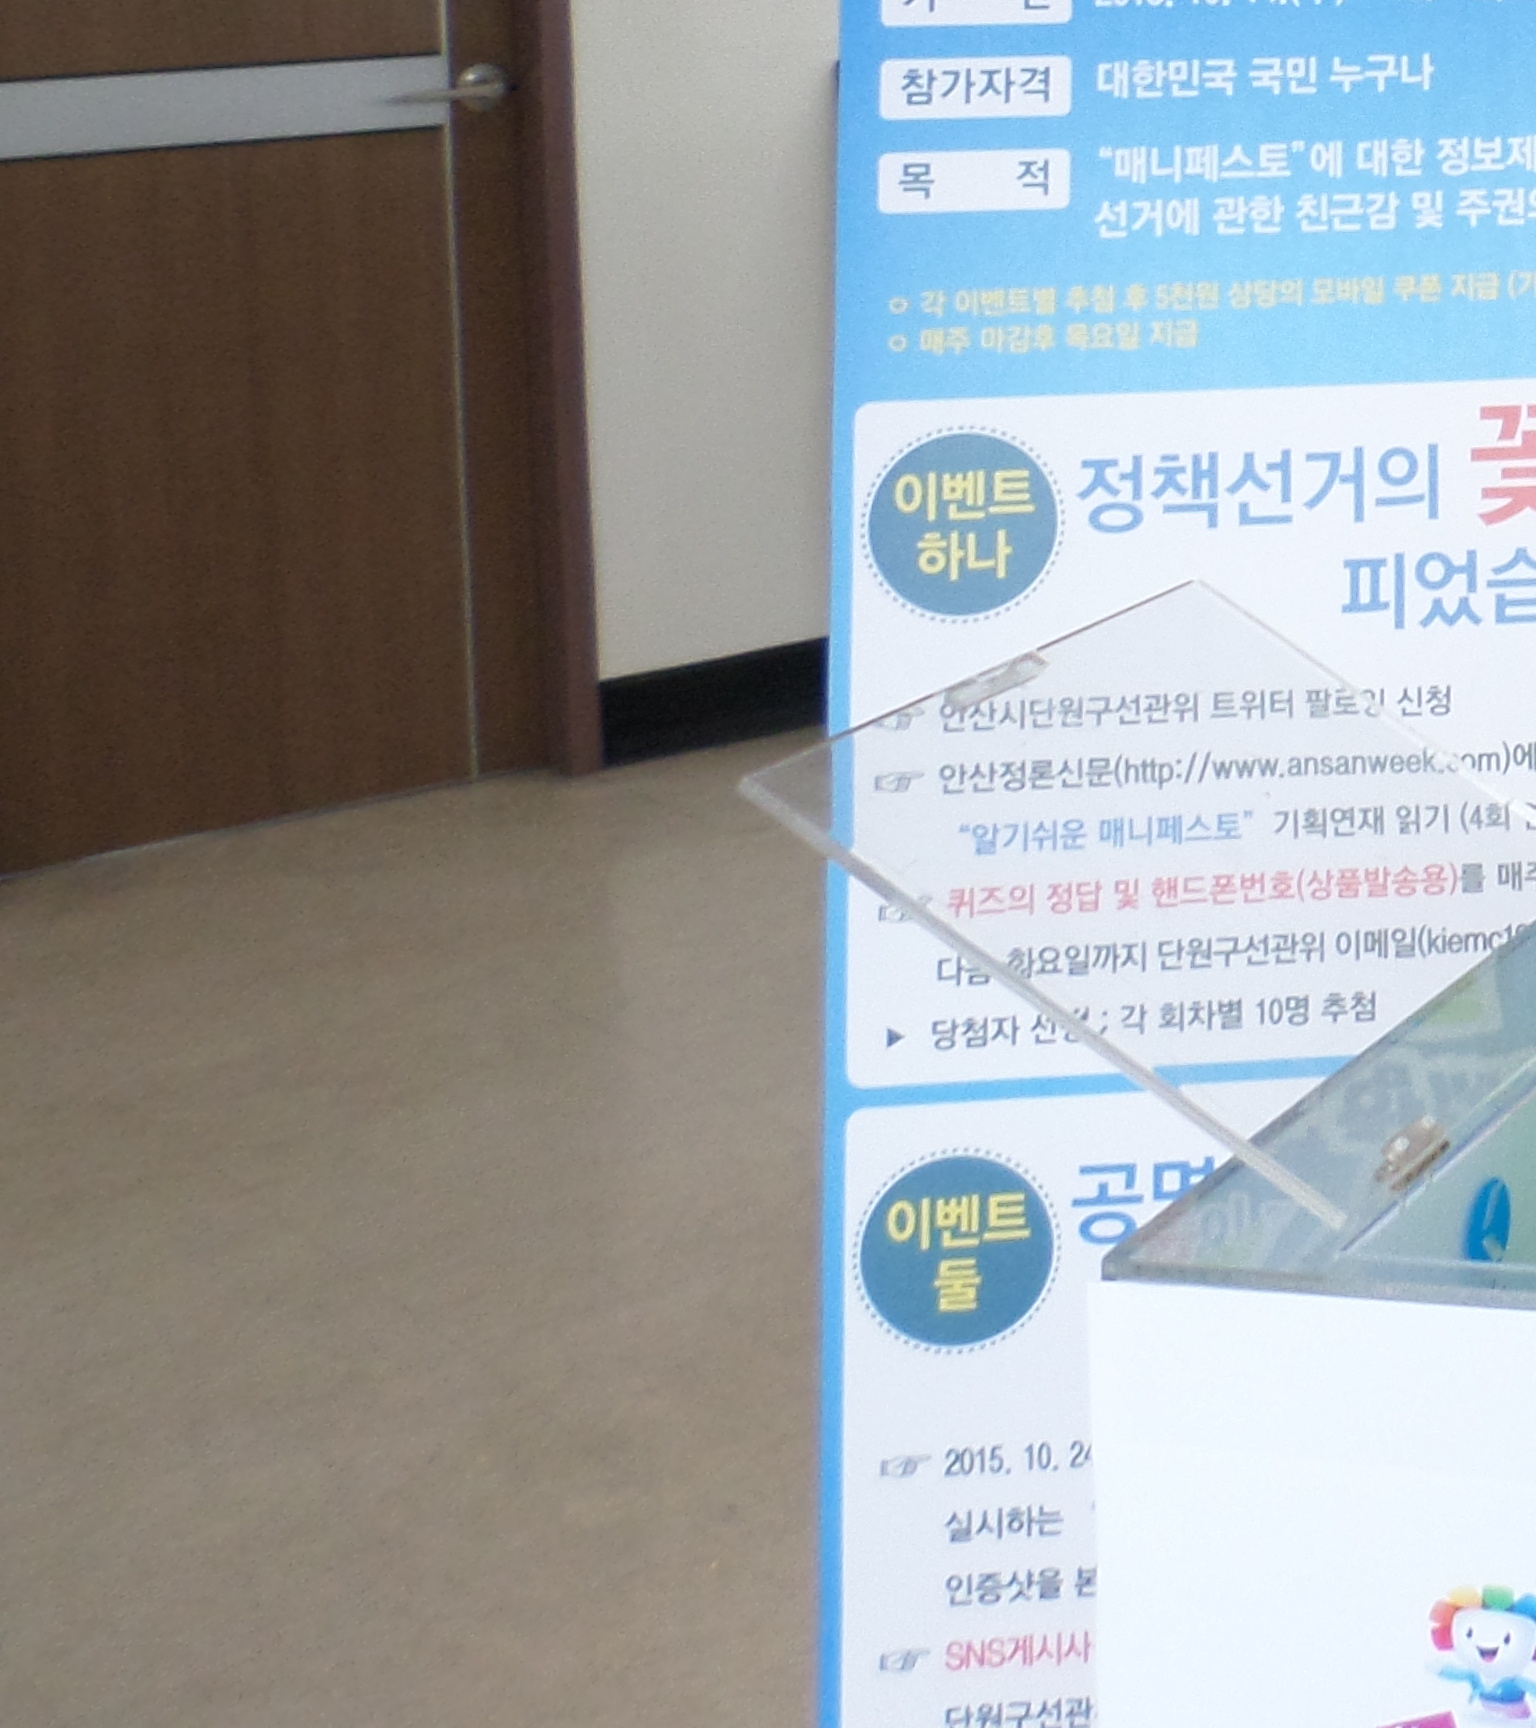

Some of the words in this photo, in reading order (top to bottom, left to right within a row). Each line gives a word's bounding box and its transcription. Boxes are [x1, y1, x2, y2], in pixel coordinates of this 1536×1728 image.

[901, 66, 1051, 106] 참가자격
[1095, 58, 1237, 99] 대한민국
[1248, 56, 1317, 95] 국민
[1330, 52, 1434, 93] 누구나
[1356, 138, 1425, 178] 대한
[1094, 197, 1200, 239] 선거에
[1213, 194, 1285, 235] 관한
[1296, 191, 1400, 233] 친근감
[1411, 190, 1443, 229] 및
[921, 289, 947, 317] 각
[955, 285, 1057, 317] 이벤트별
[1065, 283, 1116, 314] 추첨
[1155, 280, 1221, 311] 5천원
[1229, 277, 1304, 310] 상당의
[1311, 275, 1386, 305] 모바일
[1393, 273, 1442, 303] 쿠폰
[1451, 271, 1501, 301] 지급
[919, 326, 971, 356] 매주
[980, 323, 1055, 354] 마감후
[1065, 320, 1141, 352] 목요일
[1149, 318, 1198, 349] 지급
[894, 466, 1037, 526] 이벤트
[1075, 441, 1443, 534] 정책선거의
[917, 530, 1012, 584] 하나
[938, 690, 1200, 733] 안산시단원구선관위
[1210, 688, 1295, 721] 트위터
[1397, 684, 1453, 718] 신청
[1273, 804, 1386, 839] 기획연재
[1395, 802, 1450, 835] 읽기
[1459, 799, 1511, 835] (4회
[947, 883, 1036, 919] 퀴즈의
[1046, 880, 1103, 914] 정답
[1113, 878, 1140, 910] 및
[1157, 931, 1326, 972] 단원구선관위
[930, 1016, 1019, 1051] 당첨자
[1120, 1004, 1148, 1034] 각
[1157, 998, 1244, 1033] 회차별
[1255, 994, 1311, 1027] 10명
[1320, 990, 1377, 1024] 추첨
[887, 1191, 1032, 1253] 이벤트
[933, 1256, 982, 1313] 둘
[944, 1444, 1012, 1477] 2015.
[1024, 1440, 1060, 1472] 10.
[944, 1504, 1065, 1544] 실시하는
[945, 1565, 1064, 1607] 인증샷을
[944, 1695, 1098, 1728] 단원구선관
